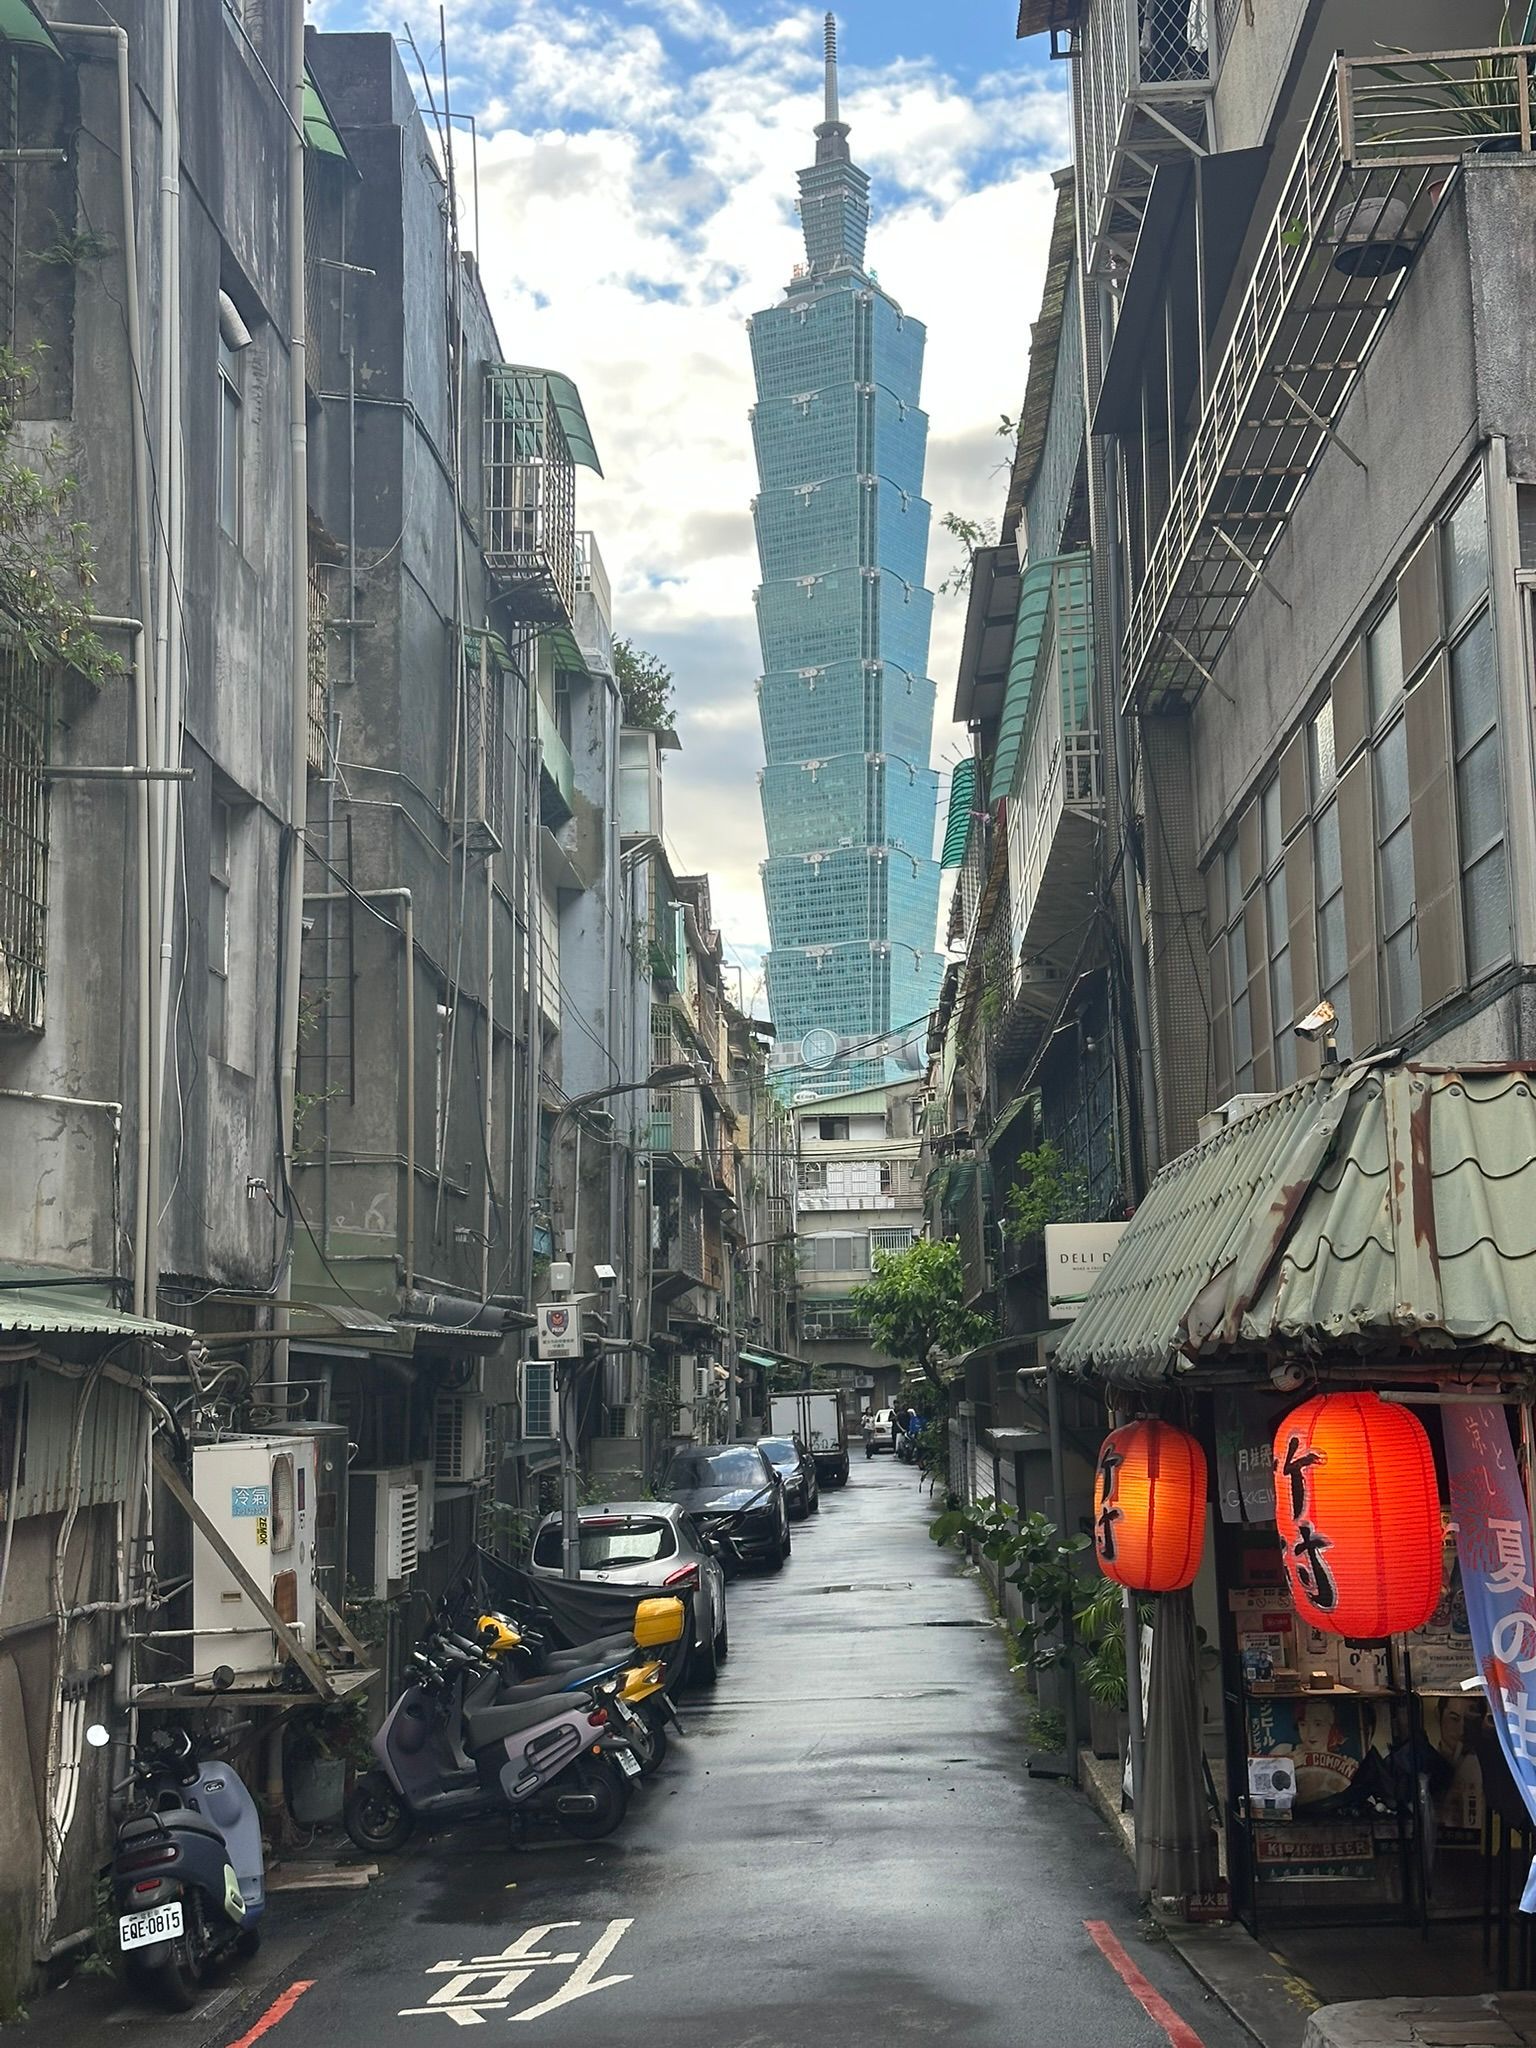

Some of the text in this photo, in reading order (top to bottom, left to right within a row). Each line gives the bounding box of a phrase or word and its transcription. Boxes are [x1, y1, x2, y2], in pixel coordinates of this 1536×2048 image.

[1060, 1252, 1094, 1264] DELI
[234, 1488, 268, 1506] 冷氣
[1267, 1842, 1313, 1857] KIRIN
[1322, 1841, 1366, 1857] BEER
